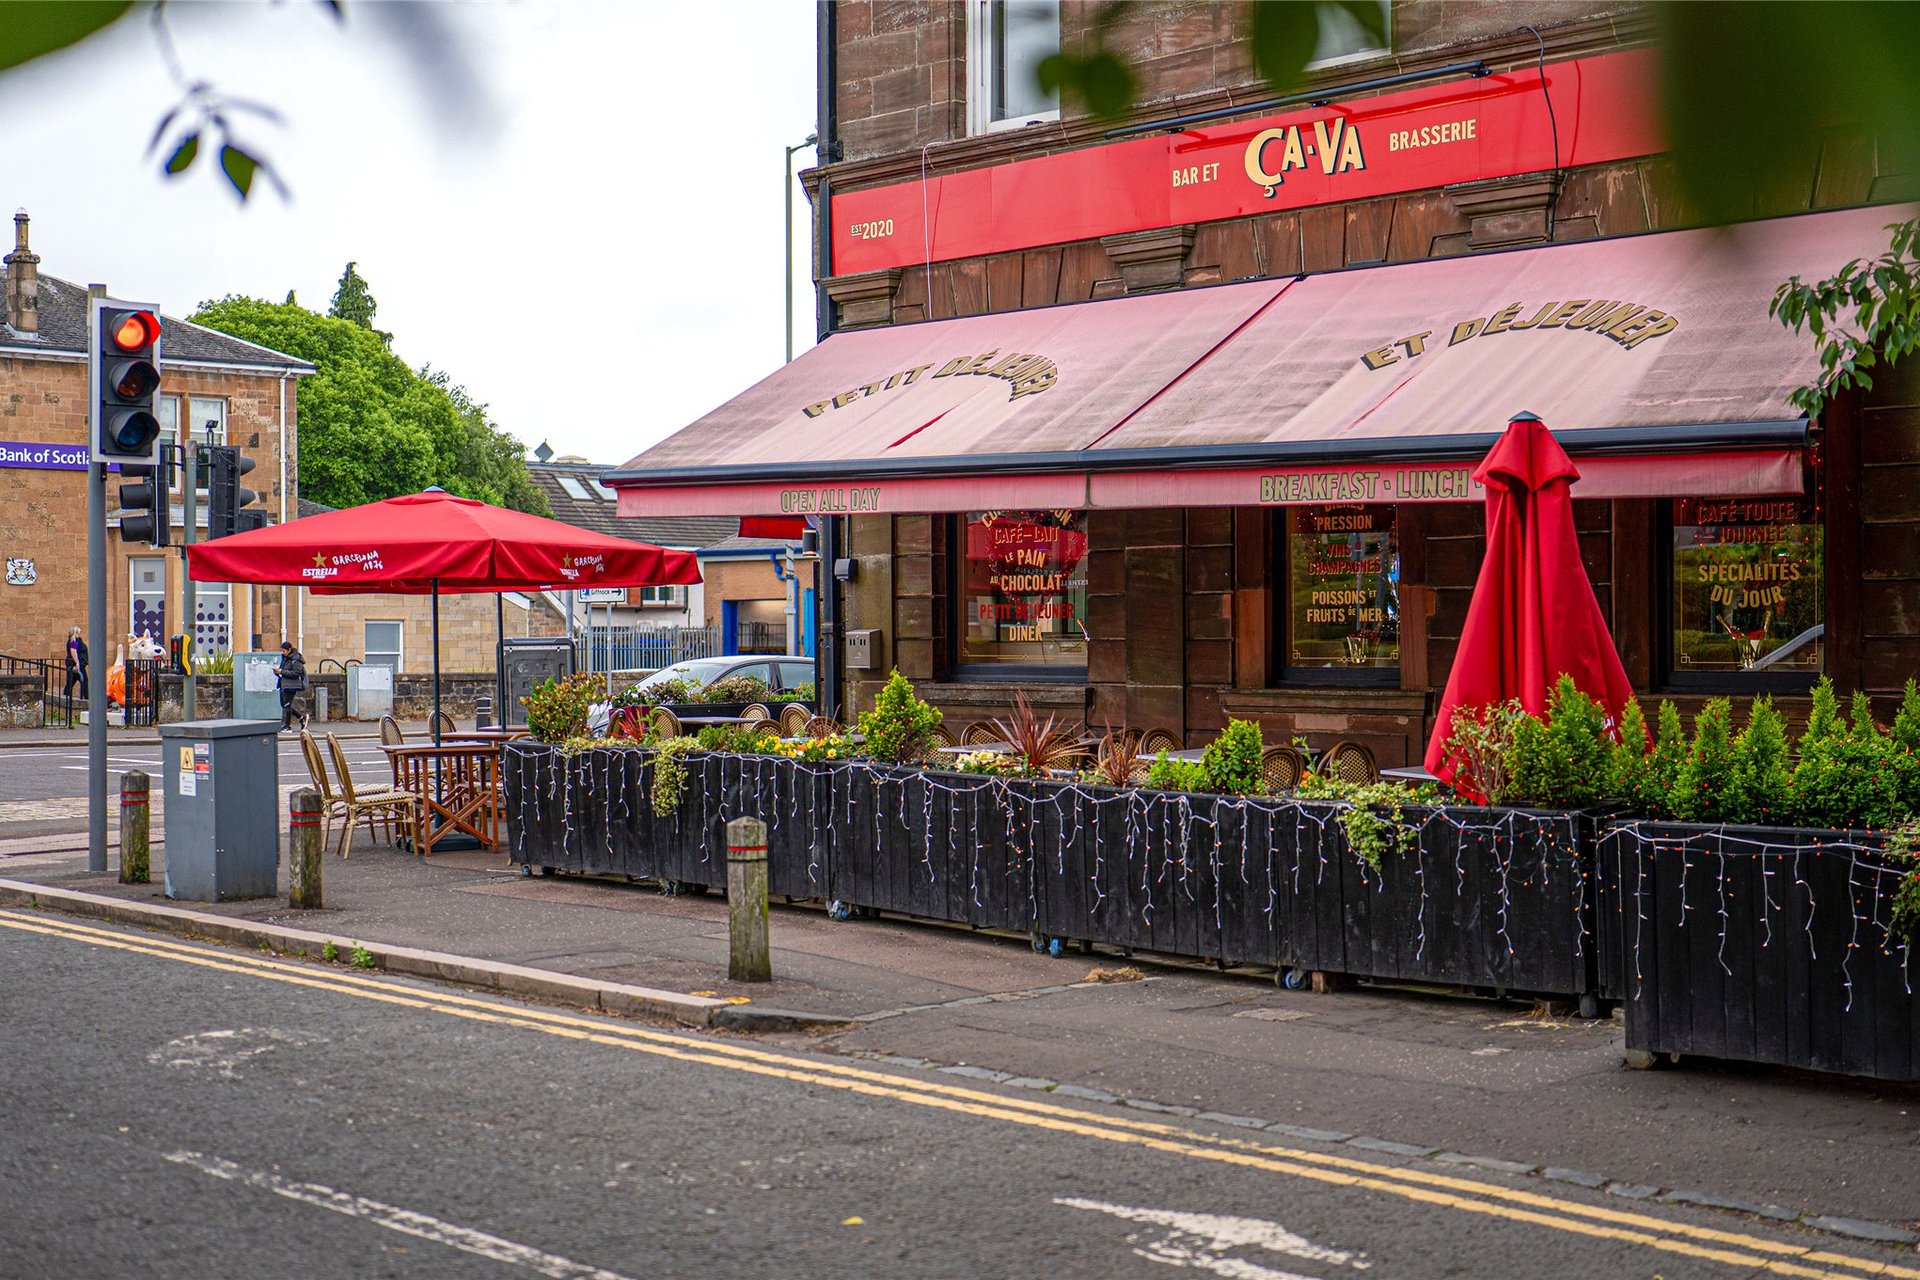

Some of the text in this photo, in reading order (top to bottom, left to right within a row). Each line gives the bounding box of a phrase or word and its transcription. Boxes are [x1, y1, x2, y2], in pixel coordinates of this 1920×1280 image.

[1172, 166, 1198, 187] BAR
[1202, 163, 1220, 183] ET
[1389, 118, 1476, 152] BRASSERIE
[851, 218, 894, 240] EST 2020
[1360, 299, 1679, 371] ET DÉJEUNER
[802, 362, 935, 418] PETIT
[0, 447, 90, 465] Bank of Scotl
[1260, 469, 1468, 502] BREAKFAST LUNCH
[781, 487, 881, 513] OPEN ALL DAY
[1697, 500, 1795, 523] CAFÉ TOUTE
[1316, 514, 1372, 531] PRESSION
[1005, 548, 1046, 568] LE PAIN
[1326, 543, 1353, 558] VINS
[302, 567, 339, 577] ESTRELLA
[1308, 559, 1383, 575] CHAMPAGNES
[990, 574, 1063, 592] AU CHOCOLAT
[1312, 589, 1377, 605] POISSONS ET
[1711, 585, 1786, 608] DU JOUR
[980, 603, 1011, 619] PETIT
[1306, 608, 1346, 623] FRUITS
[1359, 607, 1383, 622] MER
[1009, 621, 1043, 642] DÎNER
